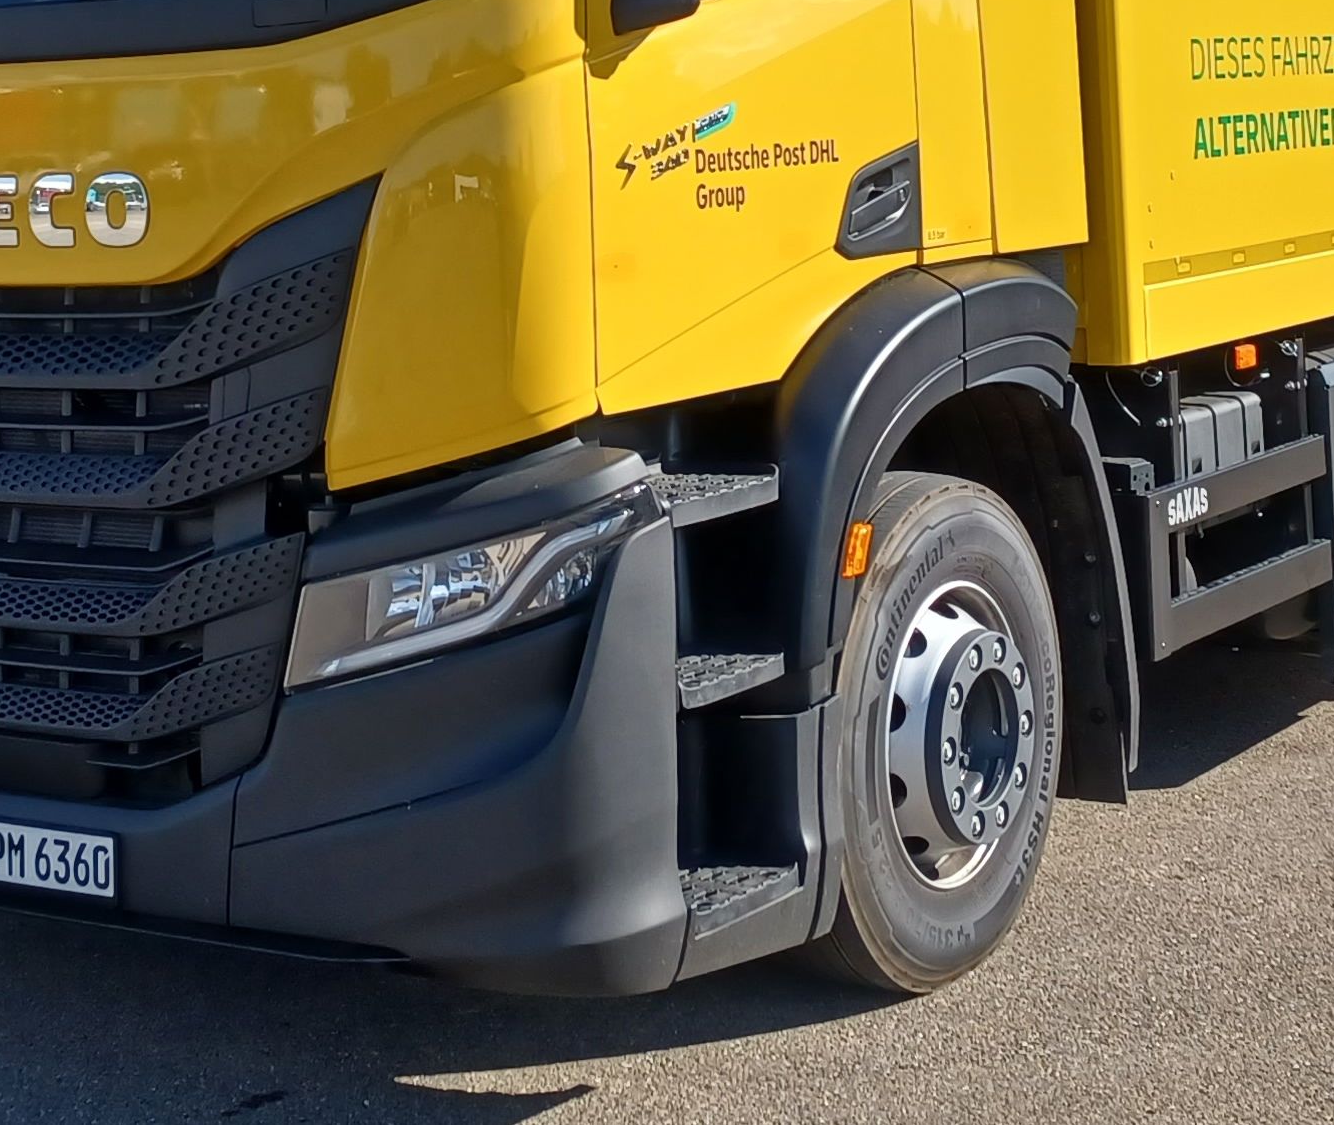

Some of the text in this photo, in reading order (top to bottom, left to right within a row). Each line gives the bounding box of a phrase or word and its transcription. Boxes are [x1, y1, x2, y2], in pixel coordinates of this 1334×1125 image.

[1190, 36, 1265, 80] DIESES
[695, 139, 839, 174] Deutsche Post DHL
[696, 183, 745, 212] Group
[1168, 487, 1208, 525] SAXAS
[875, 534, 945, 681] Continental
[1019, 810, 1044, 871] HS3
[35, 837, 110, 890] 6360
